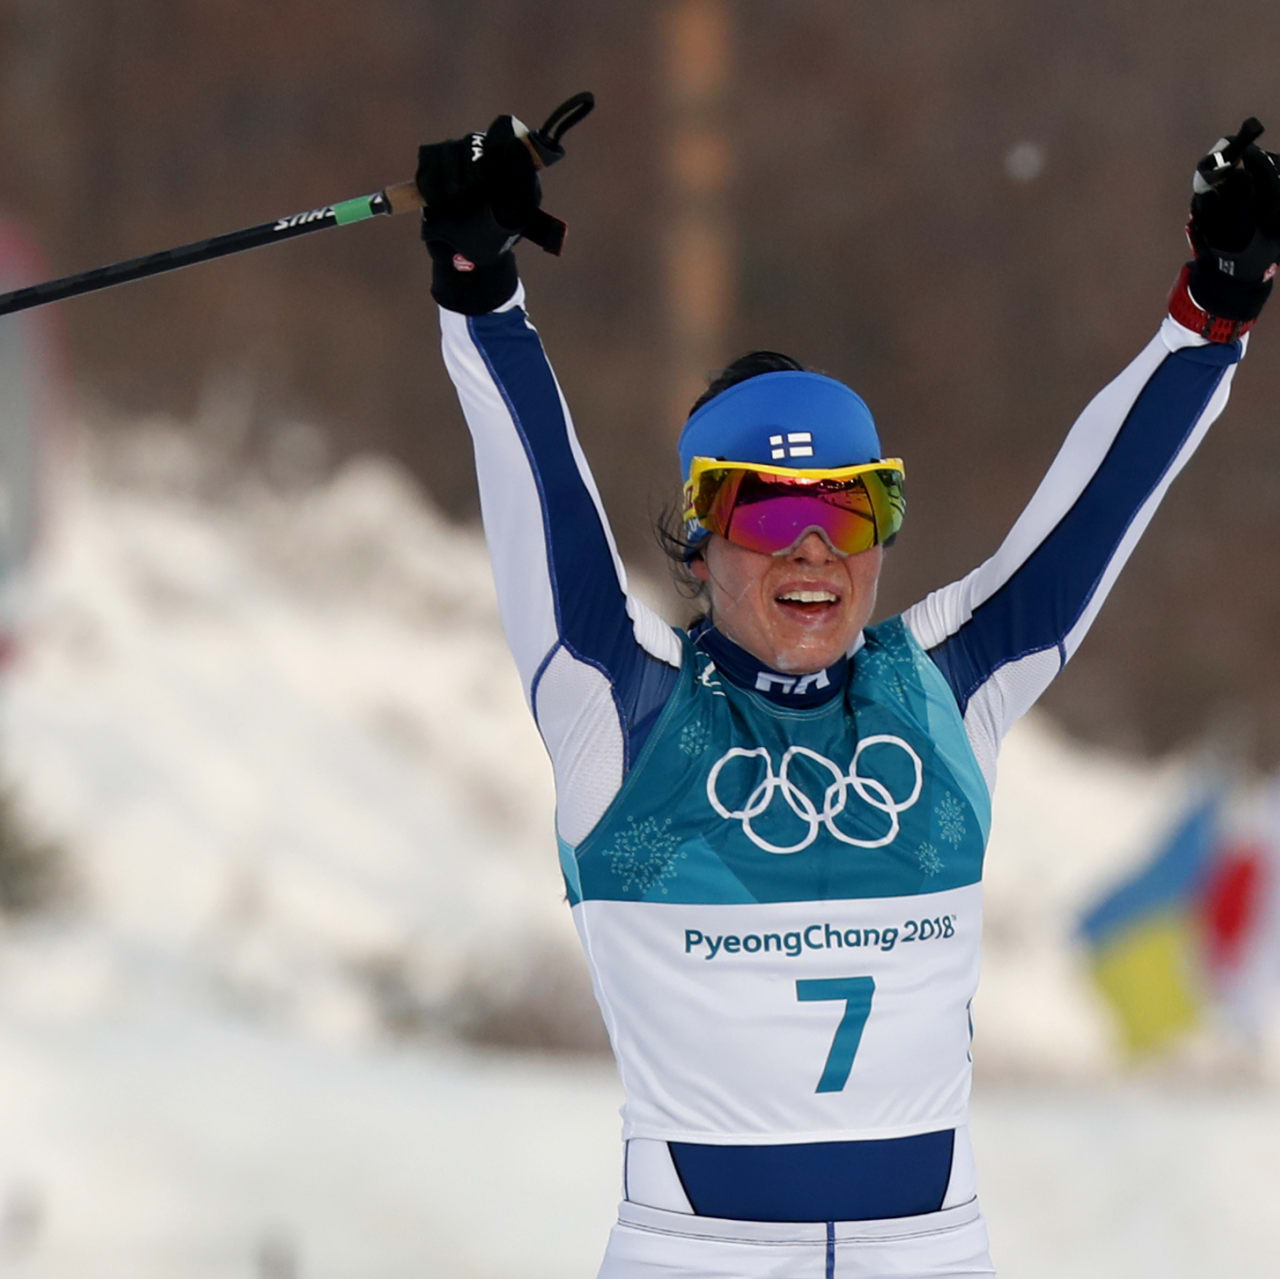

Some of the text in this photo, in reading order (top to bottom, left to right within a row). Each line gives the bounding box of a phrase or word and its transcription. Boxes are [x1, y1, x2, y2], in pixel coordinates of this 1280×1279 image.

[684, 915, 956, 961] PyeongChang 2018
[795, 975, 876, 1094] 7
